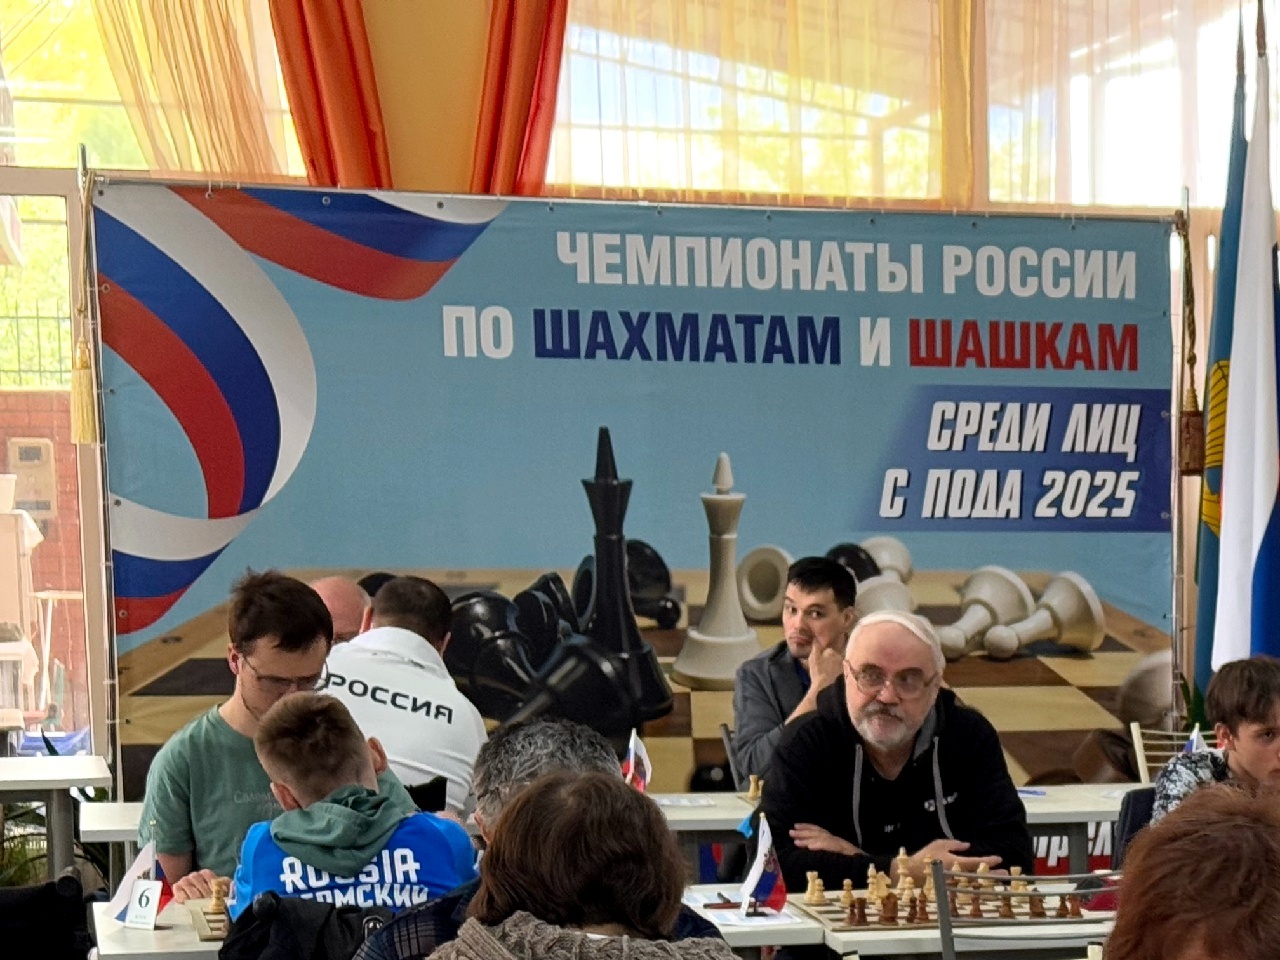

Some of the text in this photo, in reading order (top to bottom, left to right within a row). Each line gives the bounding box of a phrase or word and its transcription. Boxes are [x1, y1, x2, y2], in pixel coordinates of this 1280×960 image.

[556, 232, 1137, 299] ЧЕМПИОНАТЫ РОССИИ
[442, 305, 1139, 371] ПО ШАХМАТАМ И ШАШКАМ
[927, 401, 1142, 461] СРЕДИ ЛИЦ
[879, 468, 1140, 519] С ПОДА 2025
[327, 673, 453, 724] РОССИЯ
[280, 847, 421, 894] RUSIA
[138, 887, 151, 908] 6
